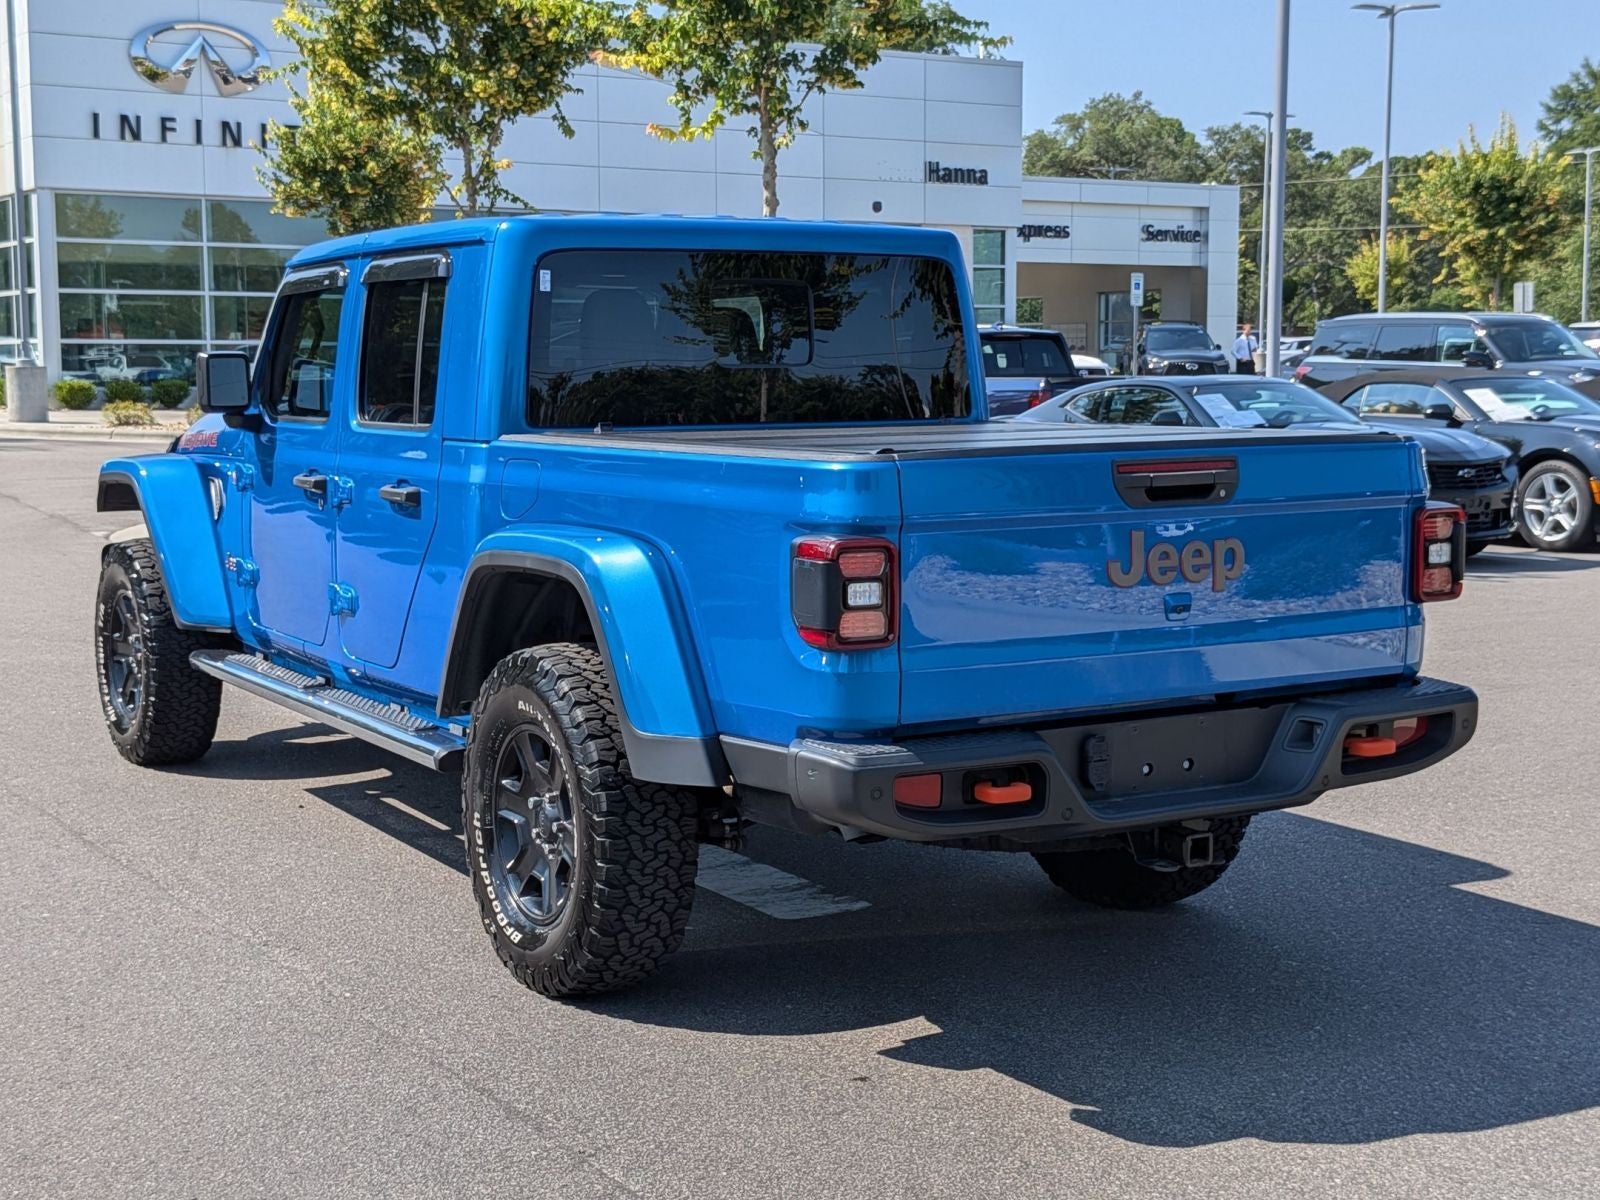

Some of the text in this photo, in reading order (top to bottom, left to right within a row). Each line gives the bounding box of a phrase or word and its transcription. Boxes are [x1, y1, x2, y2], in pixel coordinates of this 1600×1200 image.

[92, 112, 301, 149] INFINIT
[924, 161, 989, 186] Hanna
[1016, 224, 1071, 243] xpress
[1141, 224, 1202, 243] Service
[1107, 529, 1246, 593] Jeep
